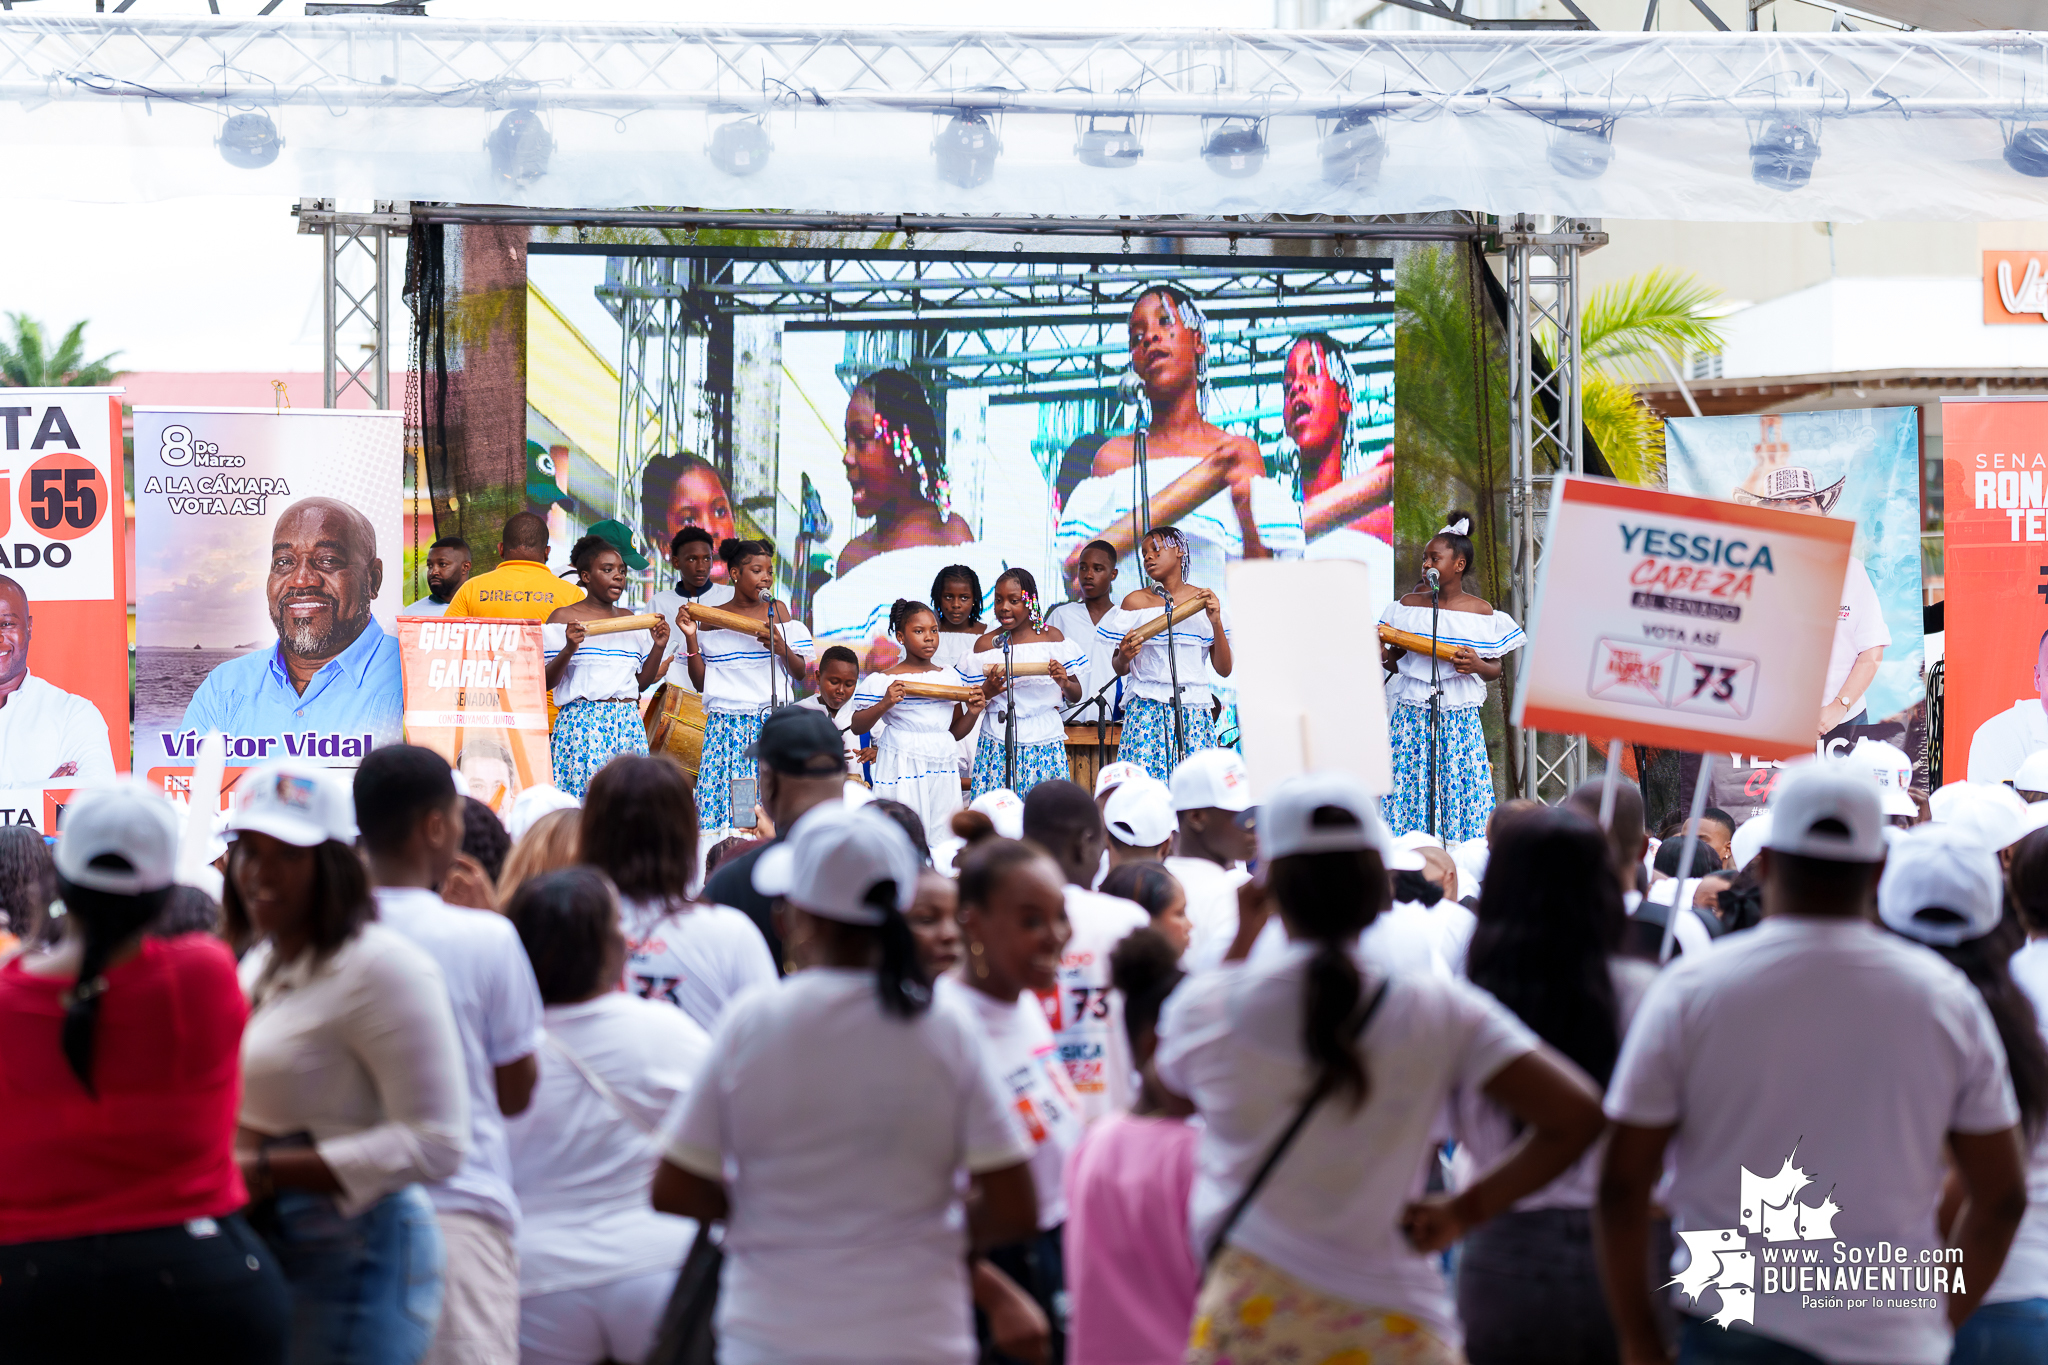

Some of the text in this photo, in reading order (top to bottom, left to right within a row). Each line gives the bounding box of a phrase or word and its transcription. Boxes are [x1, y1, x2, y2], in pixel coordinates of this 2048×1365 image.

[160, 424, 194, 467] 8
[194, 440, 219, 455] De
[194, 453, 246, 468] Marzo
[144, 473, 290, 495] A LA CÁMARA
[1975, 471, 2048, 510] RON
[31, 469, 97, 529] 55
[167, 494, 266, 515] VOTA ASÍ
[2006, 508, 2048, 542] TE
[1619, 522, 1775, 574] YESSICA
[479, 590, 555, 604] DIRECTOR
[418, 622, 521, 655] GUSTAVO
[1643, 623, 1721, 649] VOTA ASÍ
[428, 655, 512, 692] GARCÍA
[1692, 663, 1738, 701] 73
[454, 692, 500, 707] SENADOR
[438, 714, 516, 726] CONSTRUYAMOS JUNTOS
[283, 732, 373, 758] Vidal
[1070, 987, 1109, 1021] 73
